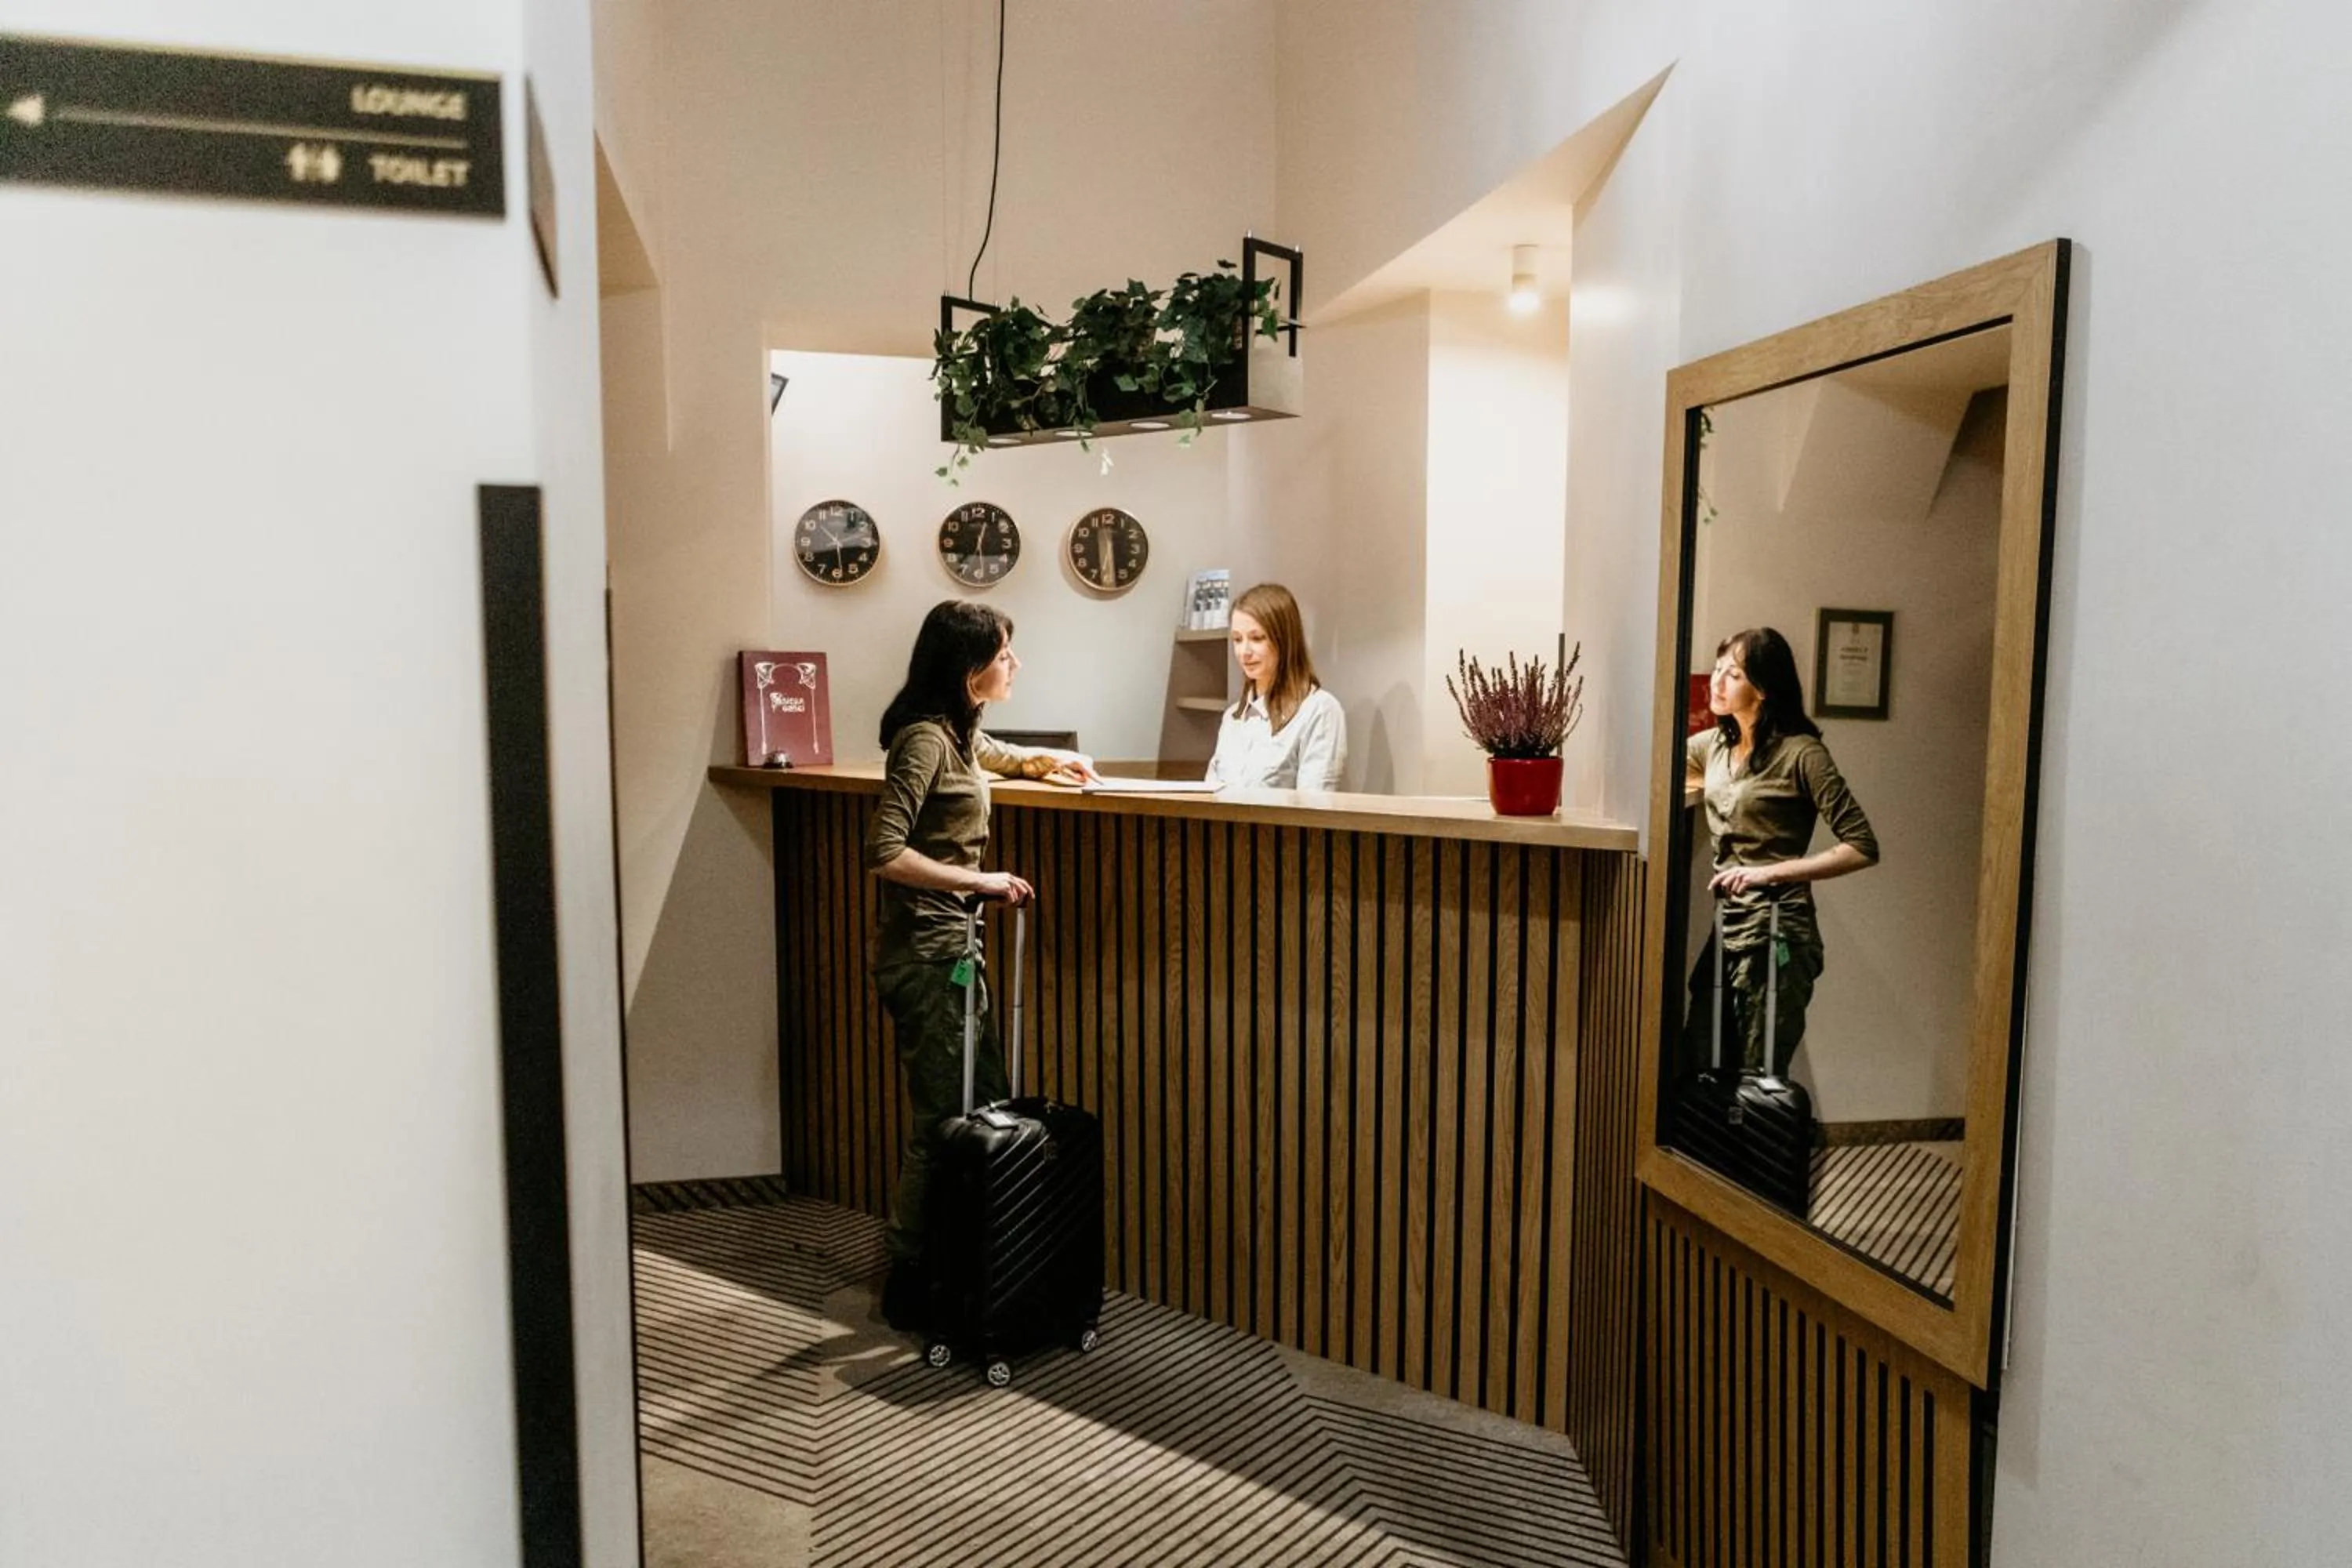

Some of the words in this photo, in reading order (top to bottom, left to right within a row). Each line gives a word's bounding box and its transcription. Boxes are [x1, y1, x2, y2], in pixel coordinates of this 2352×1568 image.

[350, 85, 467, 120] LOUNGE
[368, 154, 471, 187] TOILET
[829, 506, 844, 517] 12
[960, 510, 968, 522] 11
[972, 507, 985, 518] 12
[1091, 517, 1098, 528] 11
[1102, 514, 1115, 525] 12
[804, 520, 816, 531] 10
[948, 521, 959, 532] 10
[998, 518, 1009, 533] 2
[1078, 528, 1090, 539] 10
[1128, 529, 1138, 539] 2
[800, 536, 811, 547] 9
[943, 538, 954, 548] 9
[1002, 538, 1012, 549] 3
[1073, 543, 1084, 554] 9
[1130, 543, 1141, 555] 3
[858, 552, 868, 562] 4
[1078, 557, 1087, 568] 8
[818, 564, 826, 574] 7
[848, 564, 859, 574] 5
[1128, 559, 1137, 568] 4
[831, 568, 843, 579] 6
[960, 564, 968, 575] 7
[989, 564, 999, 575] 5
[1090, 568, 1098, 579] 7
[1118, 568, 1128, 579] 5
